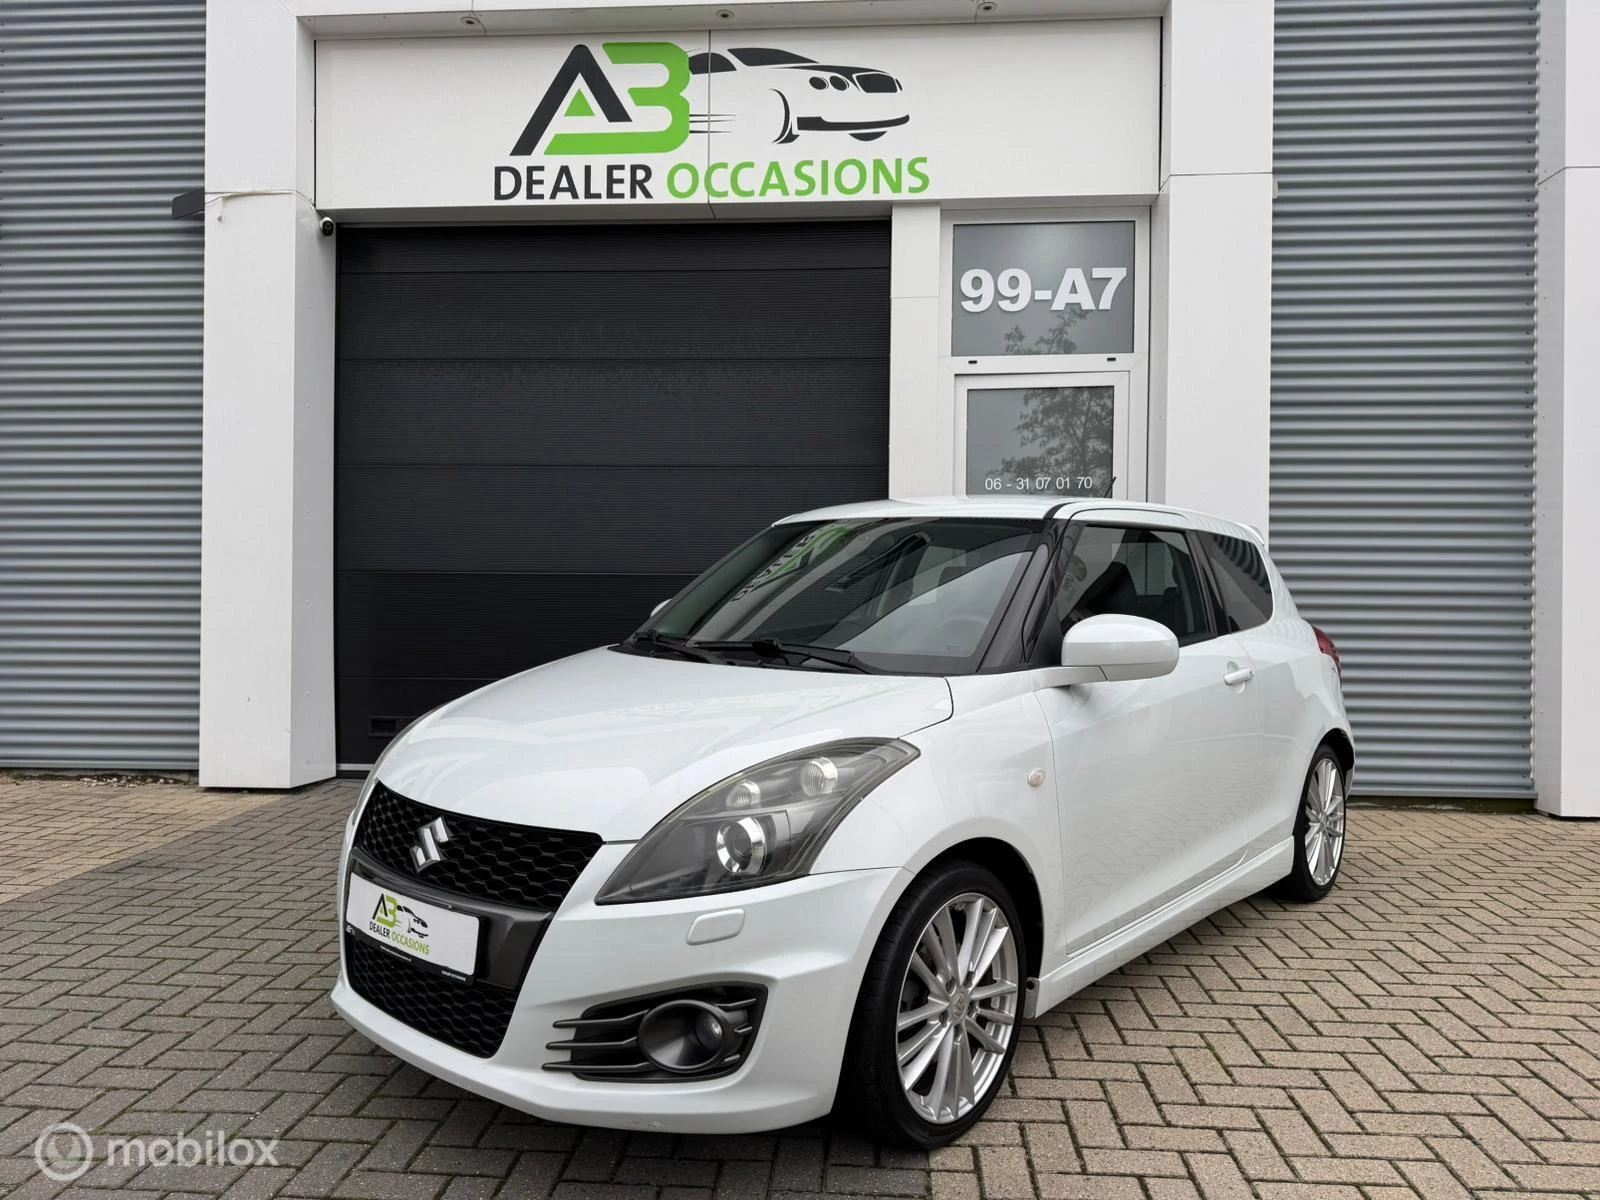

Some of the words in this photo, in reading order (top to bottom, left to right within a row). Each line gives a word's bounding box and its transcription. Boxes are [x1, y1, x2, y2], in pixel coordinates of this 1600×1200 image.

[509, 42, 690, 156] AB
[494, 164, 653, 200] DEALER
[666, 157, 930, 198] OCCASIONS
[960, 267, 1127, 312] 99-A7
[984, 477, 1002, 490] 06
[1016, 477, 1030, 490] 31
[1035, 477, 1051, 490] 07
[1056, 476, 1070, 489] 01
[1077, 476, 1093, 489] 70
[369, 921, 391, 940] DEALER
[391, 932, 431, 955] OCCASIONS
